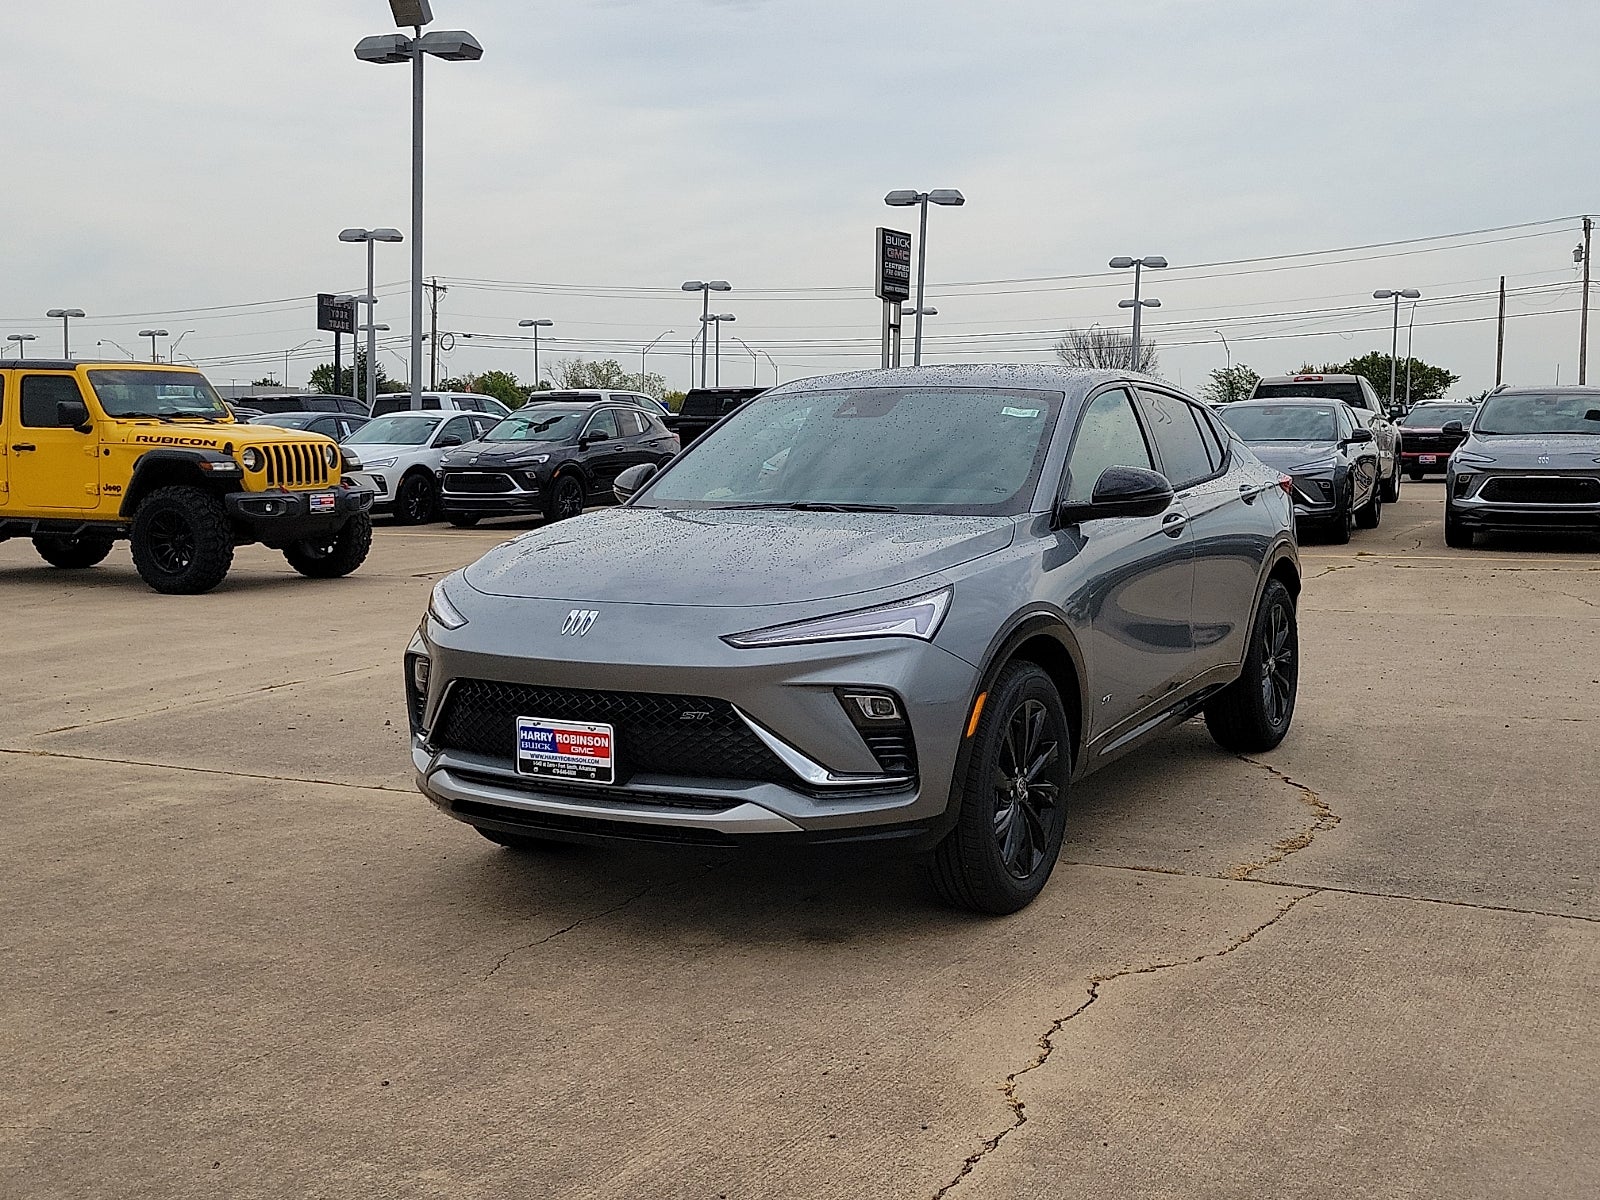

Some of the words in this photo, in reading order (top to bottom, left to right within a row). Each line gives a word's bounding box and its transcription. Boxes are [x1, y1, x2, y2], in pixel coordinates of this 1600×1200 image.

[885, 235, 910, 248] BUICK
[887, 247, 910, 260] GMC
[885, 262, 909, 272] CERTIFIED
[330, 309, 348, 319] YOUR
[328, 319, 350, 330] TRADE
[135, 435, 217, 447] RUBICON
[102, 483, 122, 493] Jeep
[680, 711, 710, 720] ST
[520, 730, 553, 742] HARRY
[555, 733, 609, 748] ROBINSON
[521, 742, 552, 750] BUICK
[571, 746, 595, 754] GMC
[530, 753, 599, 764] WWW.HARRYROBINSON.COM
